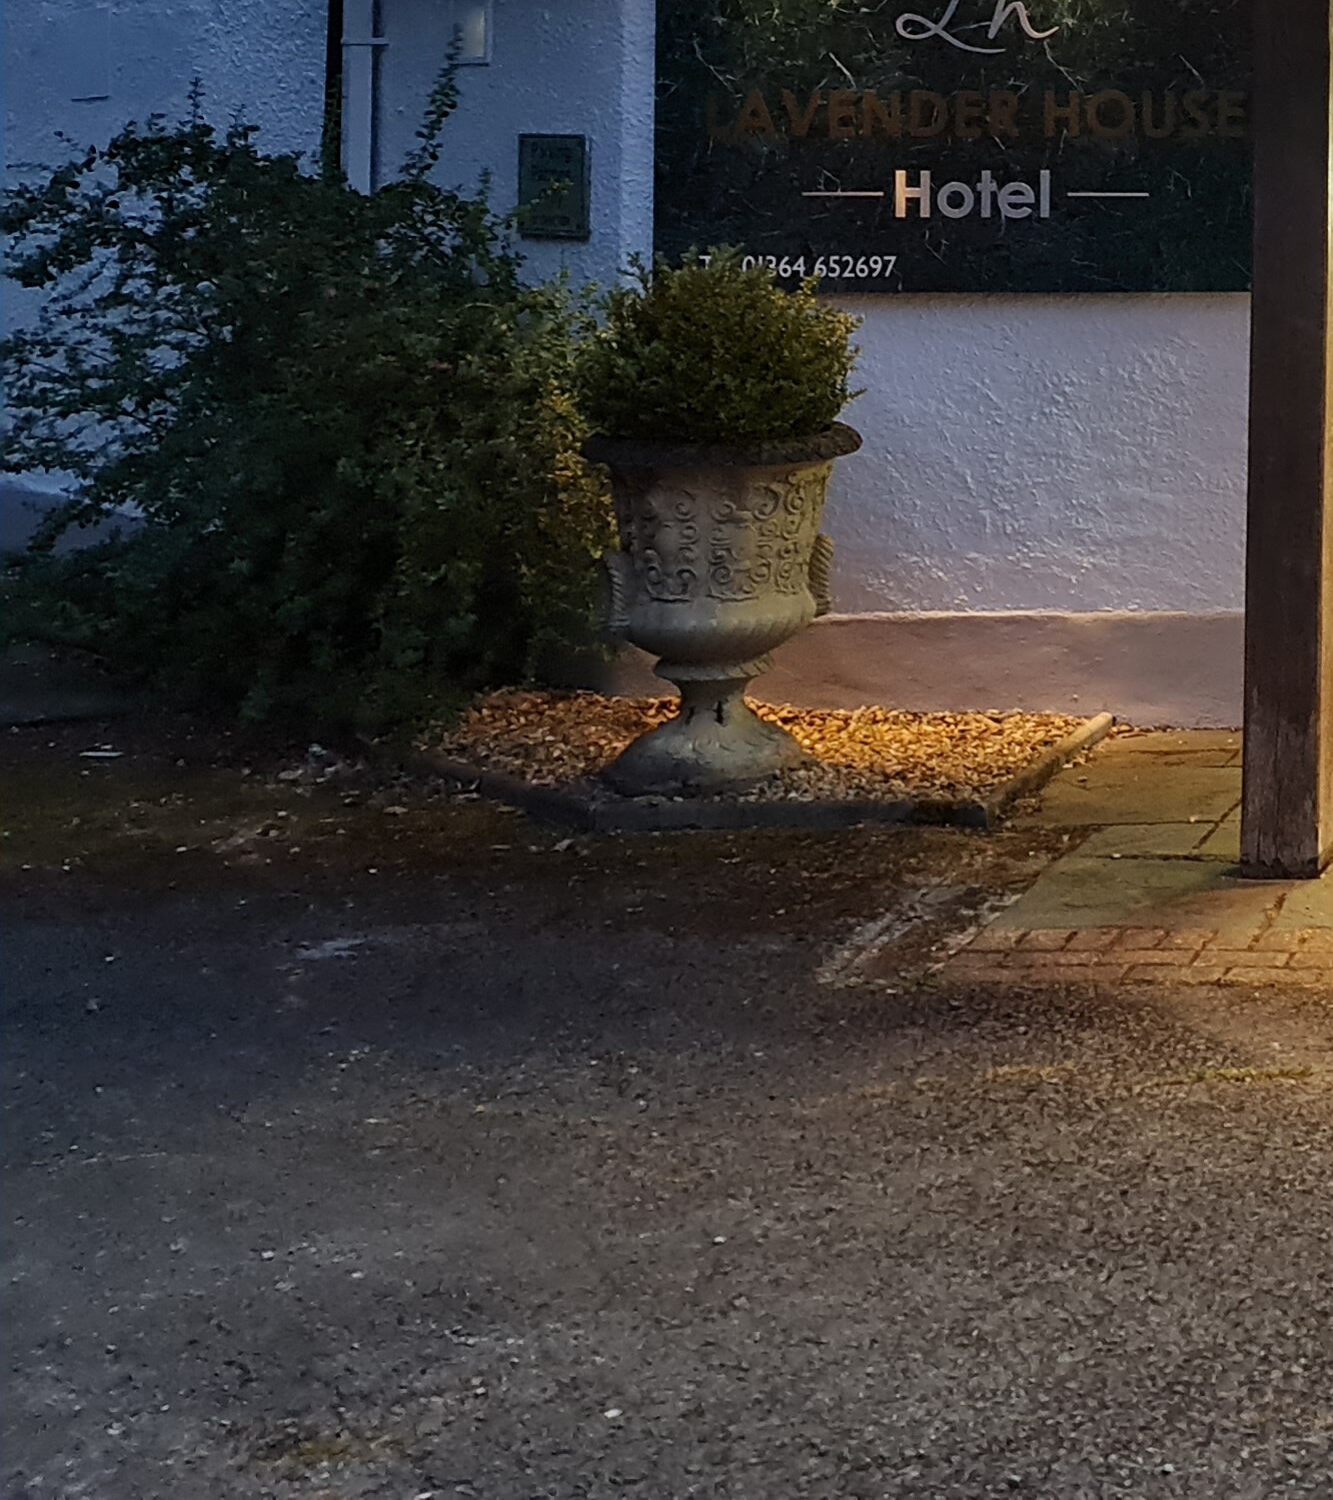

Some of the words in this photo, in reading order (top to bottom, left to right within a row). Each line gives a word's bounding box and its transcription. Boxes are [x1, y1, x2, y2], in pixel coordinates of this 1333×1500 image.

[708, 89, 1020, 139] LAVENDER
[1044, 88, 1245, 139] HOUSE
[894, 169, 1051, 219] Hotel
[814, 255, 897, 278] 652697
